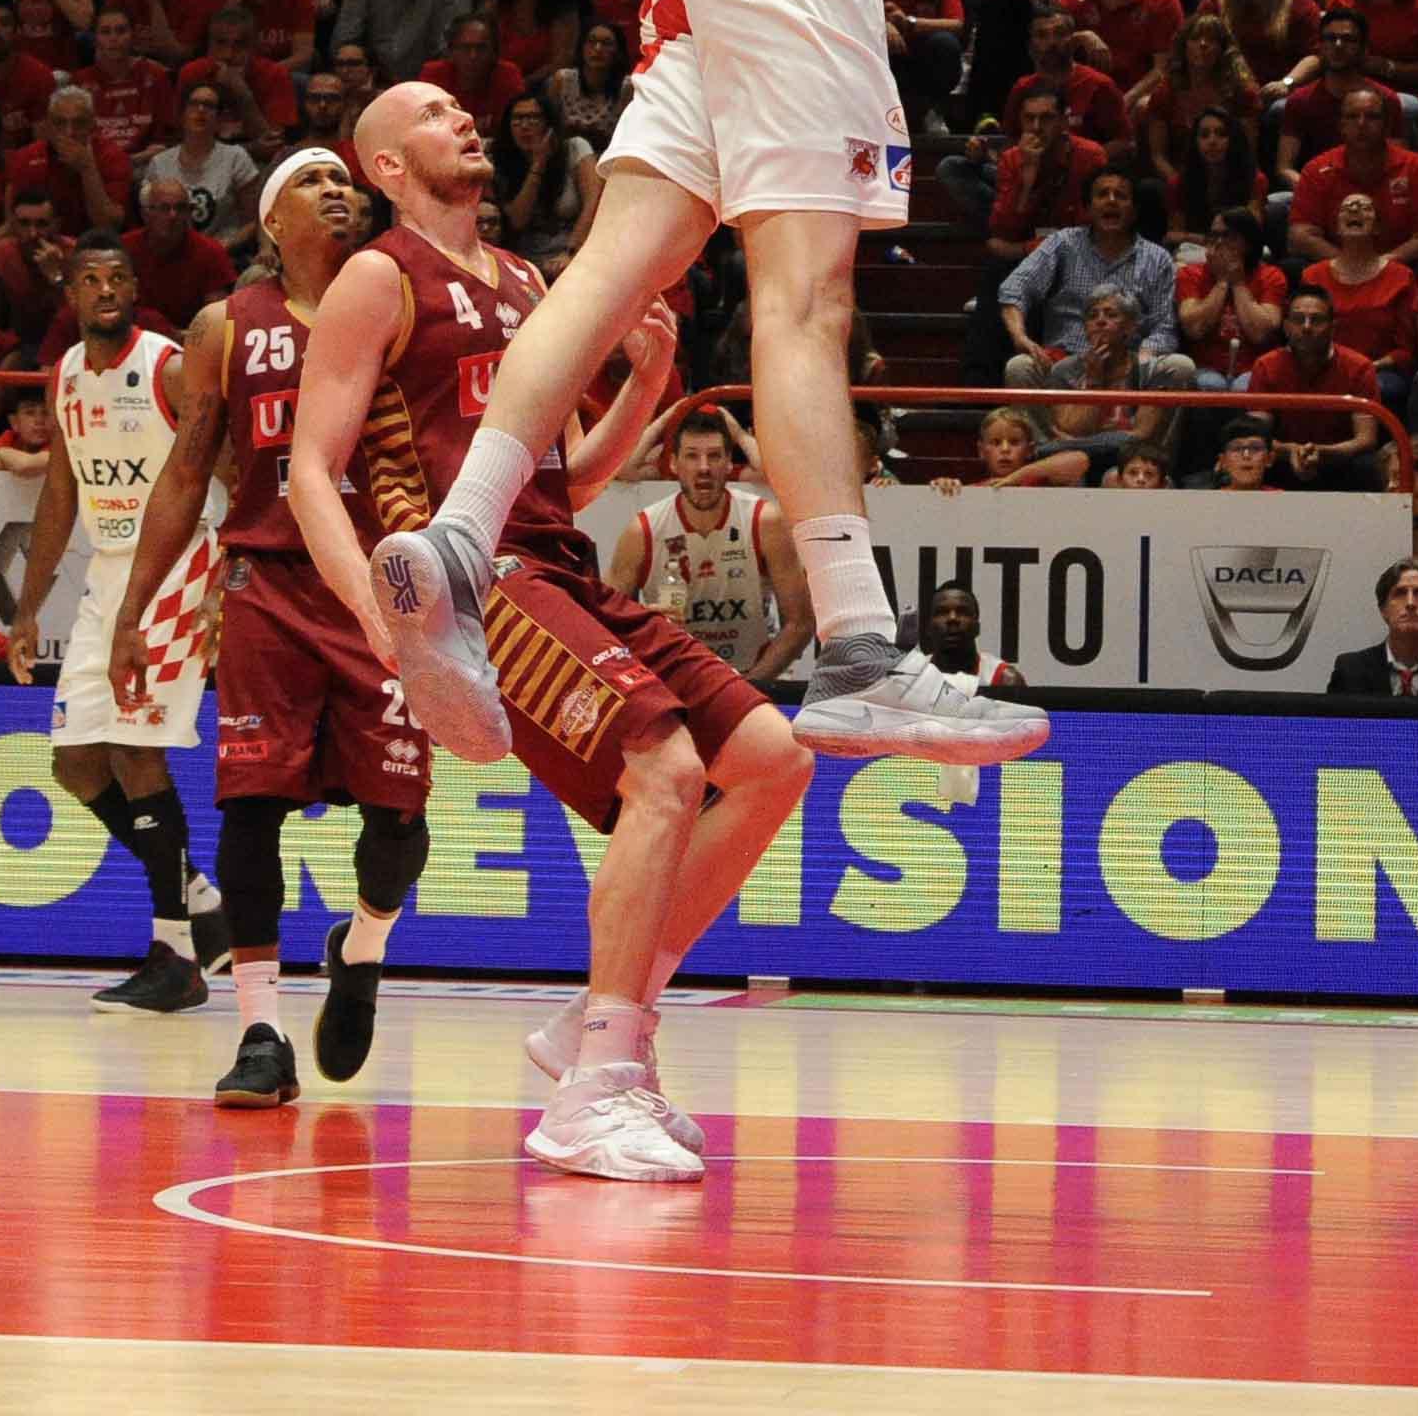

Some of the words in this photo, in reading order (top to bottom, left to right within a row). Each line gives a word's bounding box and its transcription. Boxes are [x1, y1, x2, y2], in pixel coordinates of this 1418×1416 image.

[446, 281, 484, 330] 4
[244, 325, 296, 377] 25
[64, 400, 86, 439] 11
[1213, 567, 1306, 585] DACIA
[685, 599, 748, 625] EXX
